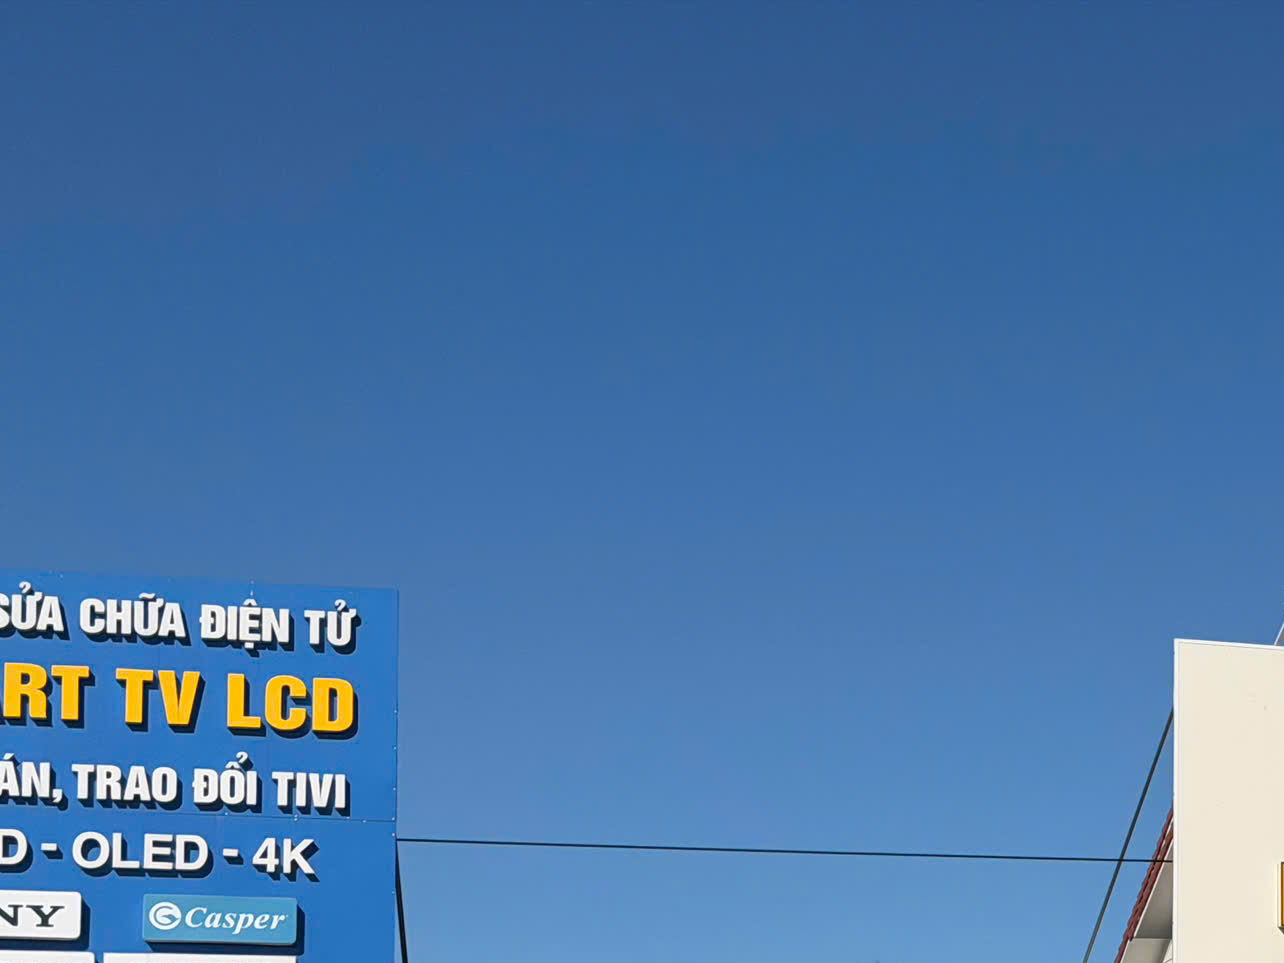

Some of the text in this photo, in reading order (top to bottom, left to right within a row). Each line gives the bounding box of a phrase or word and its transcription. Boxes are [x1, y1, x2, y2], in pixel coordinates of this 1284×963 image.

[80, 592, 186, 638] CHỮA
[200, 598, 290, 650] ĐIỆN
[304, 599, 357, 647] TỬ
[116, 668, 200, 726] TV
[227, 673, 355, 732] LCD
[72, 763, 178, 803] TRAO
[192, 752, 257, 805] ĐỔI
[272, 772, 347, 809] TIVI
[72, 832, 209, 872] OLED
[252, 837, 316, 875] 4K
[185, 906, 287, 935] Casper
